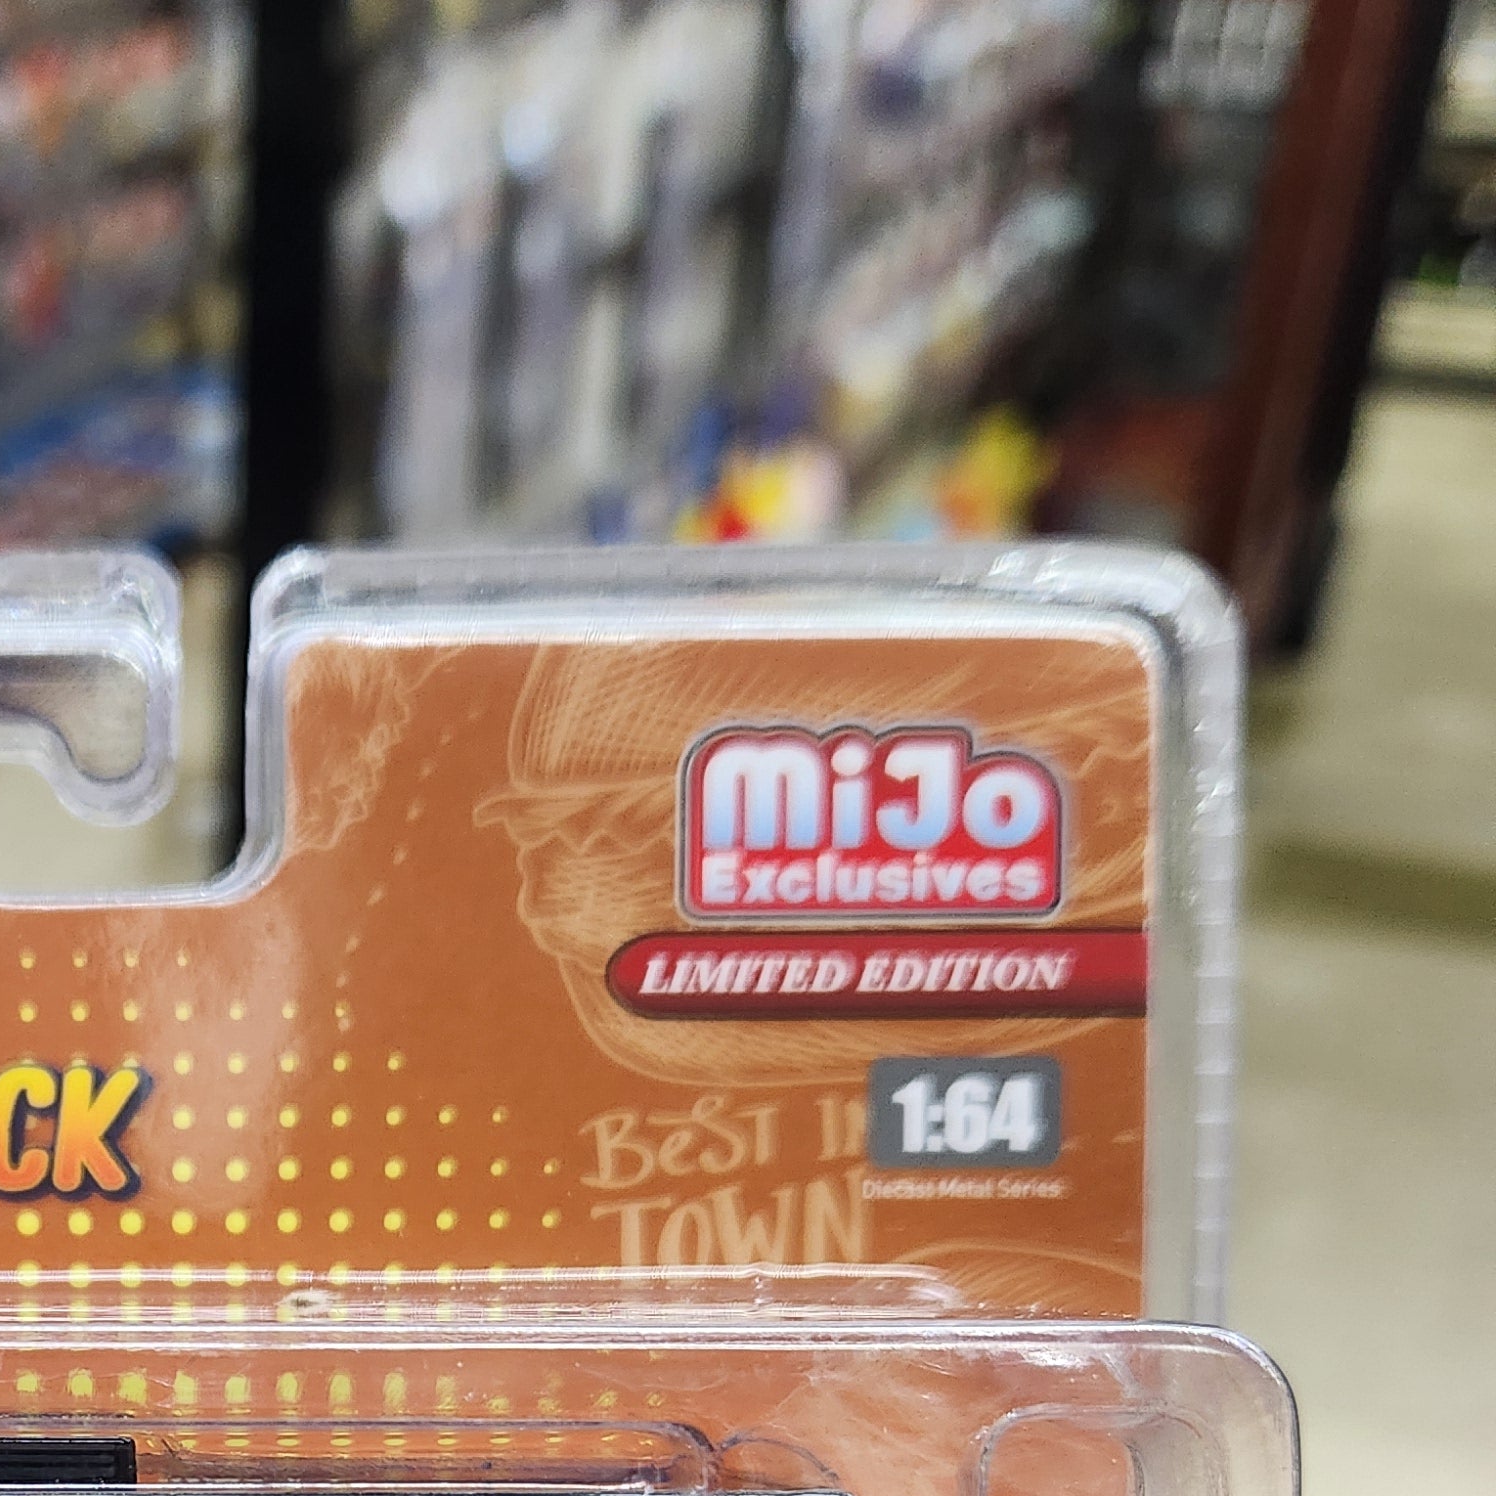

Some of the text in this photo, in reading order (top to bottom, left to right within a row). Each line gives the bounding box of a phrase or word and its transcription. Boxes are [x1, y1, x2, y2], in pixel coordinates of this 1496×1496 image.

[701, 850, 1042, 903] Exclusives
[639, 948, 1071, 995] LIMITED EDITION
[891, 1073, 1039, 1154] 1:64
[590, 1168, 870, 1290] TOWN
